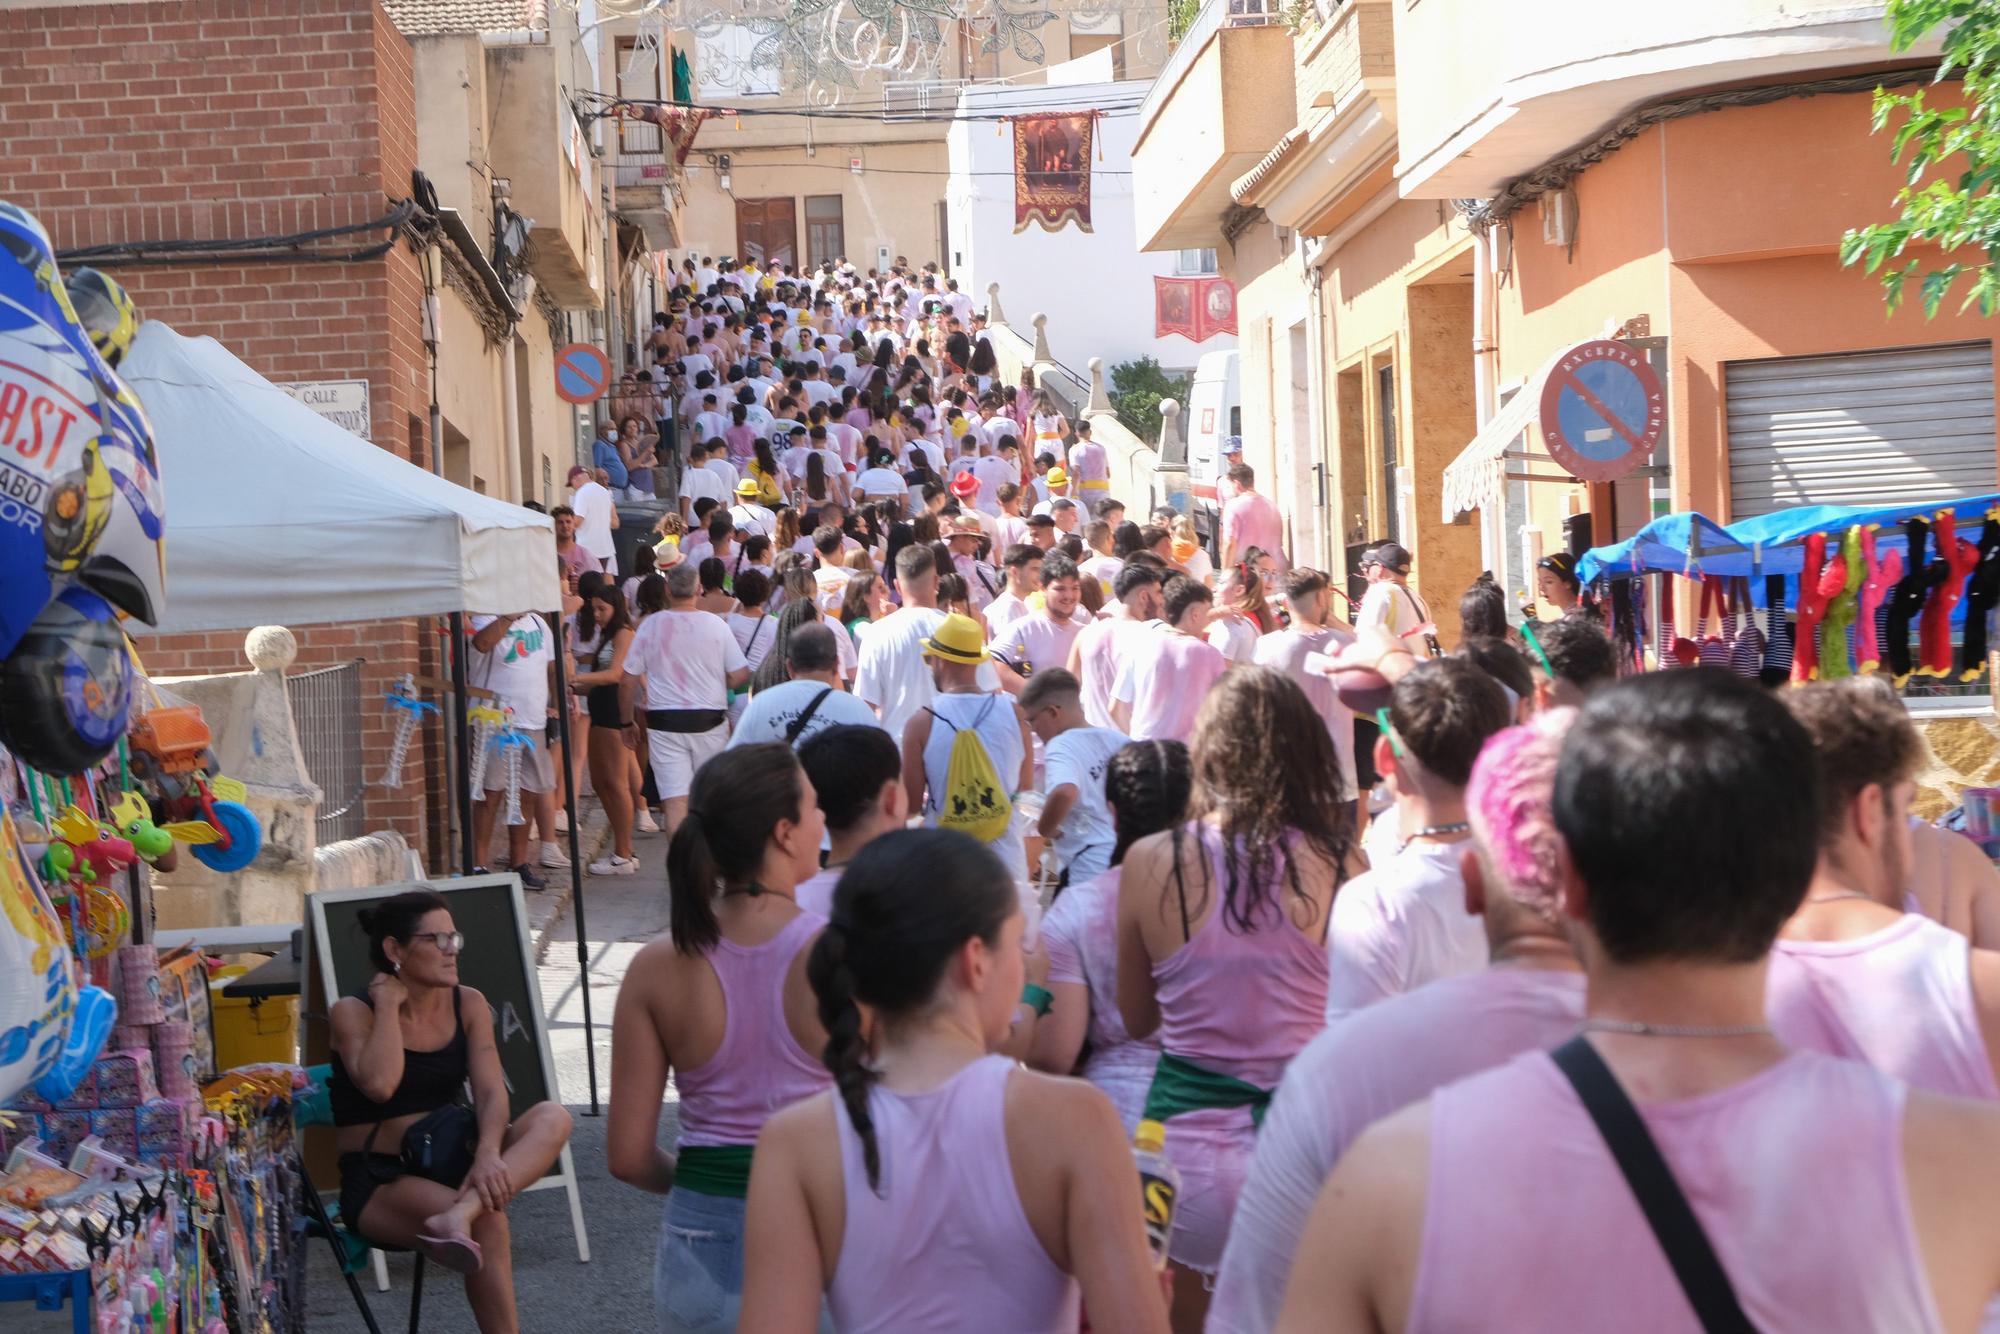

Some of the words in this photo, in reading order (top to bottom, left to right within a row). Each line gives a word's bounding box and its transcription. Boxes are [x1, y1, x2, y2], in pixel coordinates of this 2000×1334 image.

[1562, 346, 1638, 372] EXCEPTO
[303, 389, 337, 404] CALLE
[0, 378, 77, 471] AST
[772, 432, 792, 451] 98
[0, 496, 42, 536] OR
